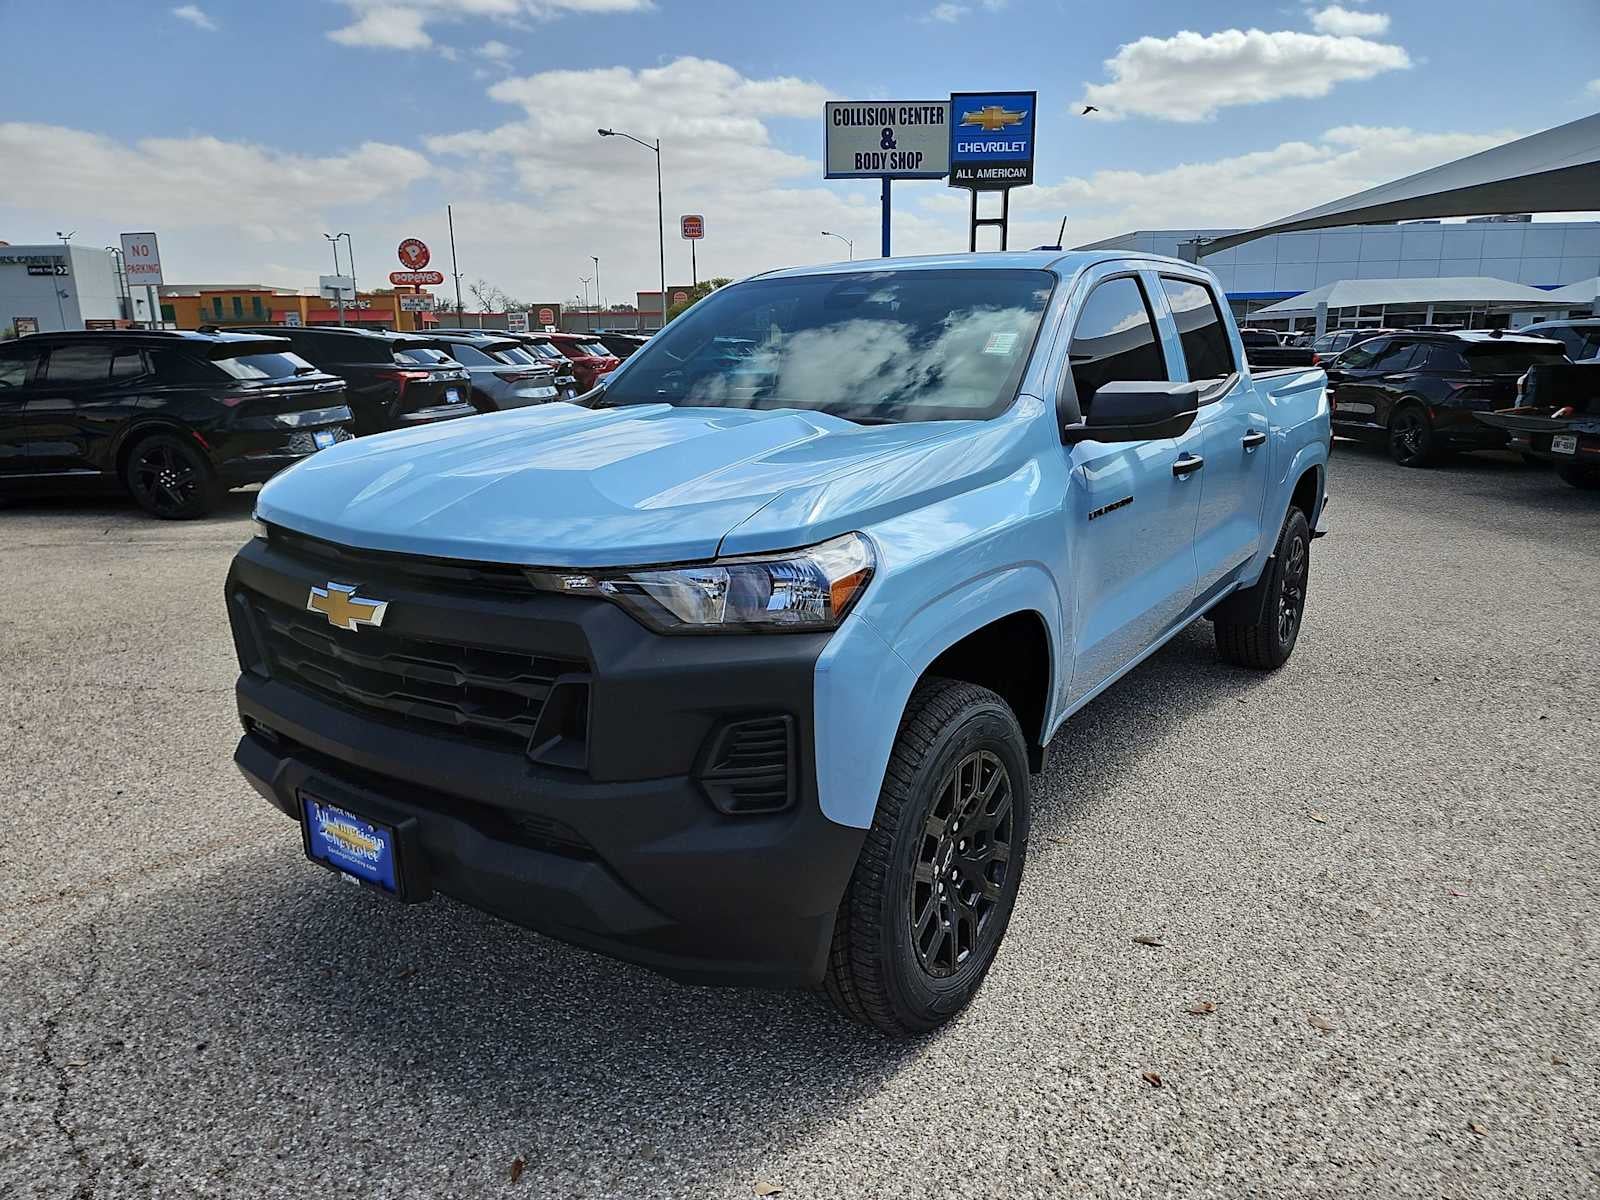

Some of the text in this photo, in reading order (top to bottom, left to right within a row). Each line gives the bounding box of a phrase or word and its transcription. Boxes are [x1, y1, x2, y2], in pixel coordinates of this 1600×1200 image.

[833, 106, 944, 126] COLLISION CENTER
[880, 127, 897, 150] &
[957, 141, 1026, 153] CHEVROLET
[854, 151, 923, 170] BODY SHOP
[956, 167, 1027, 179] ALL AMERICAN
[131, 244, 149, 257] NO
[127, 263, 160, 274] PARKING
[315, 808, 329, 826] All
[334, 817, 385, 848] American
[324, 830, 379, 862] Chevrolet
